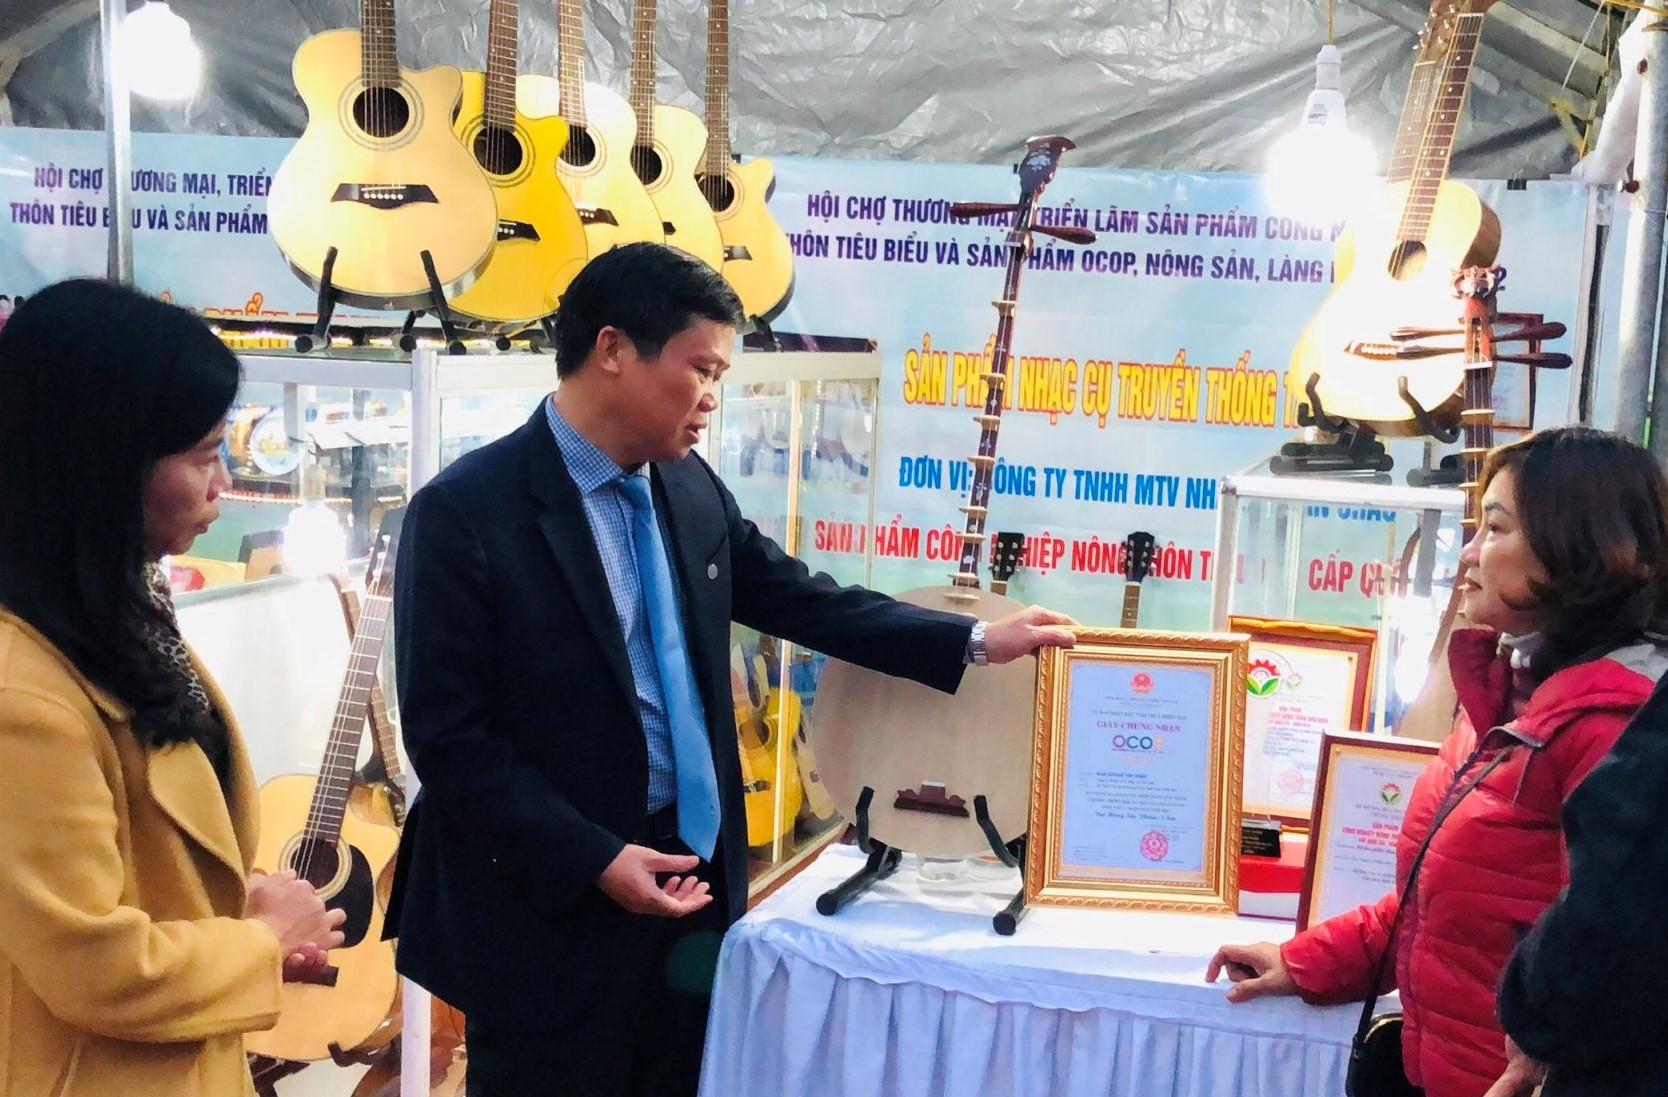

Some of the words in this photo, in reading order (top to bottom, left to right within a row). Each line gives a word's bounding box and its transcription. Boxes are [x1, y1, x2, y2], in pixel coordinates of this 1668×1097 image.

[34, 161, 63, 193] HỘI
[69, 167, 104, 195] CHỢ
[131, 169, 177, 193] ƯƠNG
[183, 172, 221, 199] MẠI,
[10, 199, 54, 226] THÔN
[60, 200, 97, 228] TIÊU
[147, 204, 169, 230] VÀ
[174, 202, 211, 232] SẢN
[216, 203, 268, 235] PHẨM
[807, 190, 840, 224] HỘI
[846, 196, 887, 227] CHỢ
[1036, 197, 1089, 228] RIỂN
[1095, 205, 1139, 234] LÃM
[1145, 203, 1189, 236] SẢN
[1195, 204, 1258, 239] PHẨM
[785, 229, 829, 258] HÔN
[836, 232, 877, 261] TIÊU
[884, 231, 929, 264] BIỂU
[935, 237, 960, 265] VÀ
[967, 236, 1008, 268] SẢN
[1027, 238, 1075, 272] HẨM
[1081, 249, 1138, 279] OCOP,
[1145, 248, 1204, 279] NÔNG
[1210, 249, 1260, 284] SẢN,
[1267, 254, 1323, 284] LÀNG
[903, 331, 948, 406] SẢN
[1017, 356, 1078, 425] NHẠC
[1081, 358, 1112, 428] CỤ
[1116, 348, 1201, 423] TRUYỀN
[1205, 350, 1278, 428] THỐNG
[899, 455, 942, 489] ĐƠN
[994, 457, 1036, 496] ÔNG
[1043, 467, 1067, 499] TY
[1074, 469, 1128, 505] TNHH
[1135, 473, 1180, 508] MTV
[1148, 540, 1194, 580] HÔN
[1308, 548, 1353, 593] CẤP
[1112, 734, 1166, 752] OCOP
